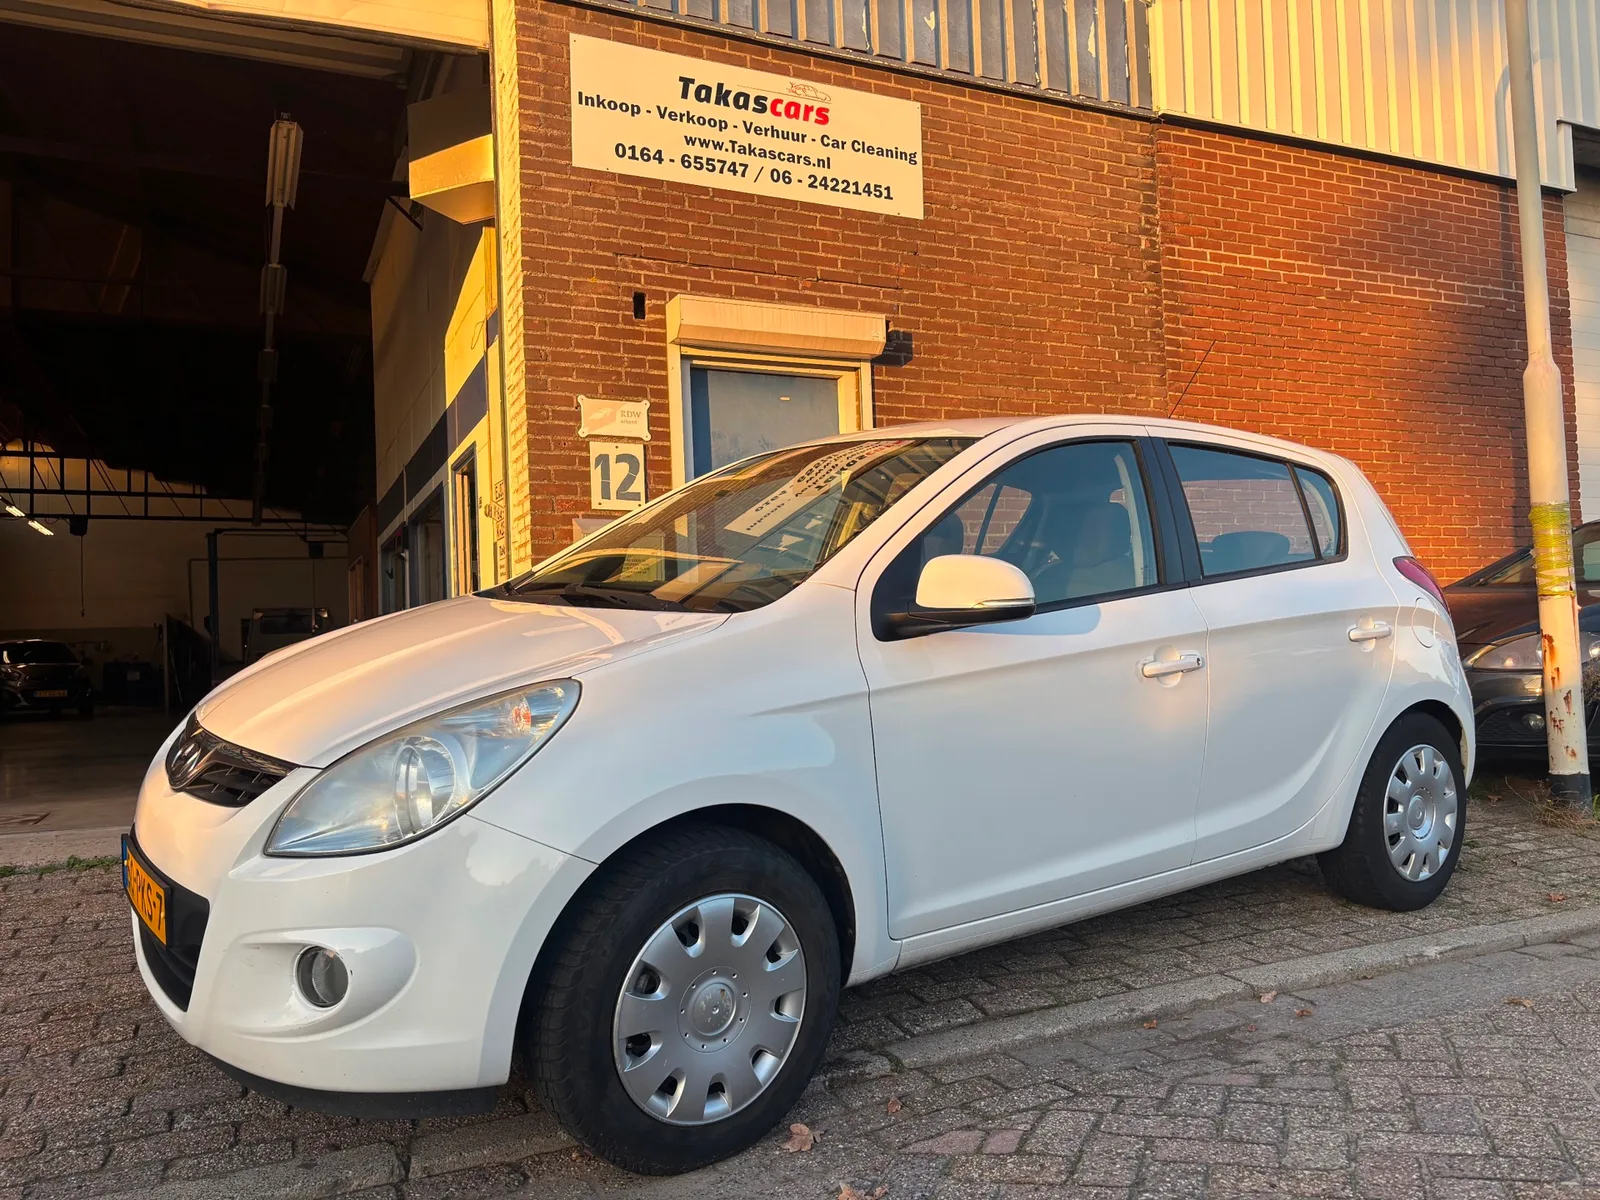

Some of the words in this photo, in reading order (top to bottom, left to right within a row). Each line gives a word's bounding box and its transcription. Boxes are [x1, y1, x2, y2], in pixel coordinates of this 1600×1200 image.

[678, 76, 830, 126] Takascars
[577, 91, 641, 116] Inkoop
[656, 106, 728, 131] Verkoop
[742, 120, 807, 144] Verhuur
[820, 134, 847, 150] Car
[851, 140, 918, 165] Cleaning
[684, 134, 830, 169] www.Takascars.nl
[615, 142, 664, 164] 0164
[680, 154, 749, 178] 655747
[754, 166, 764, 183] /
[770, 167, 793, 185] 06
[808, 174, 894, 200] 24221451
[620, 410, 641, 418] RDW
[594, 453, 641, 501] 12
[127, 851, 163, 931] -PKS-7
